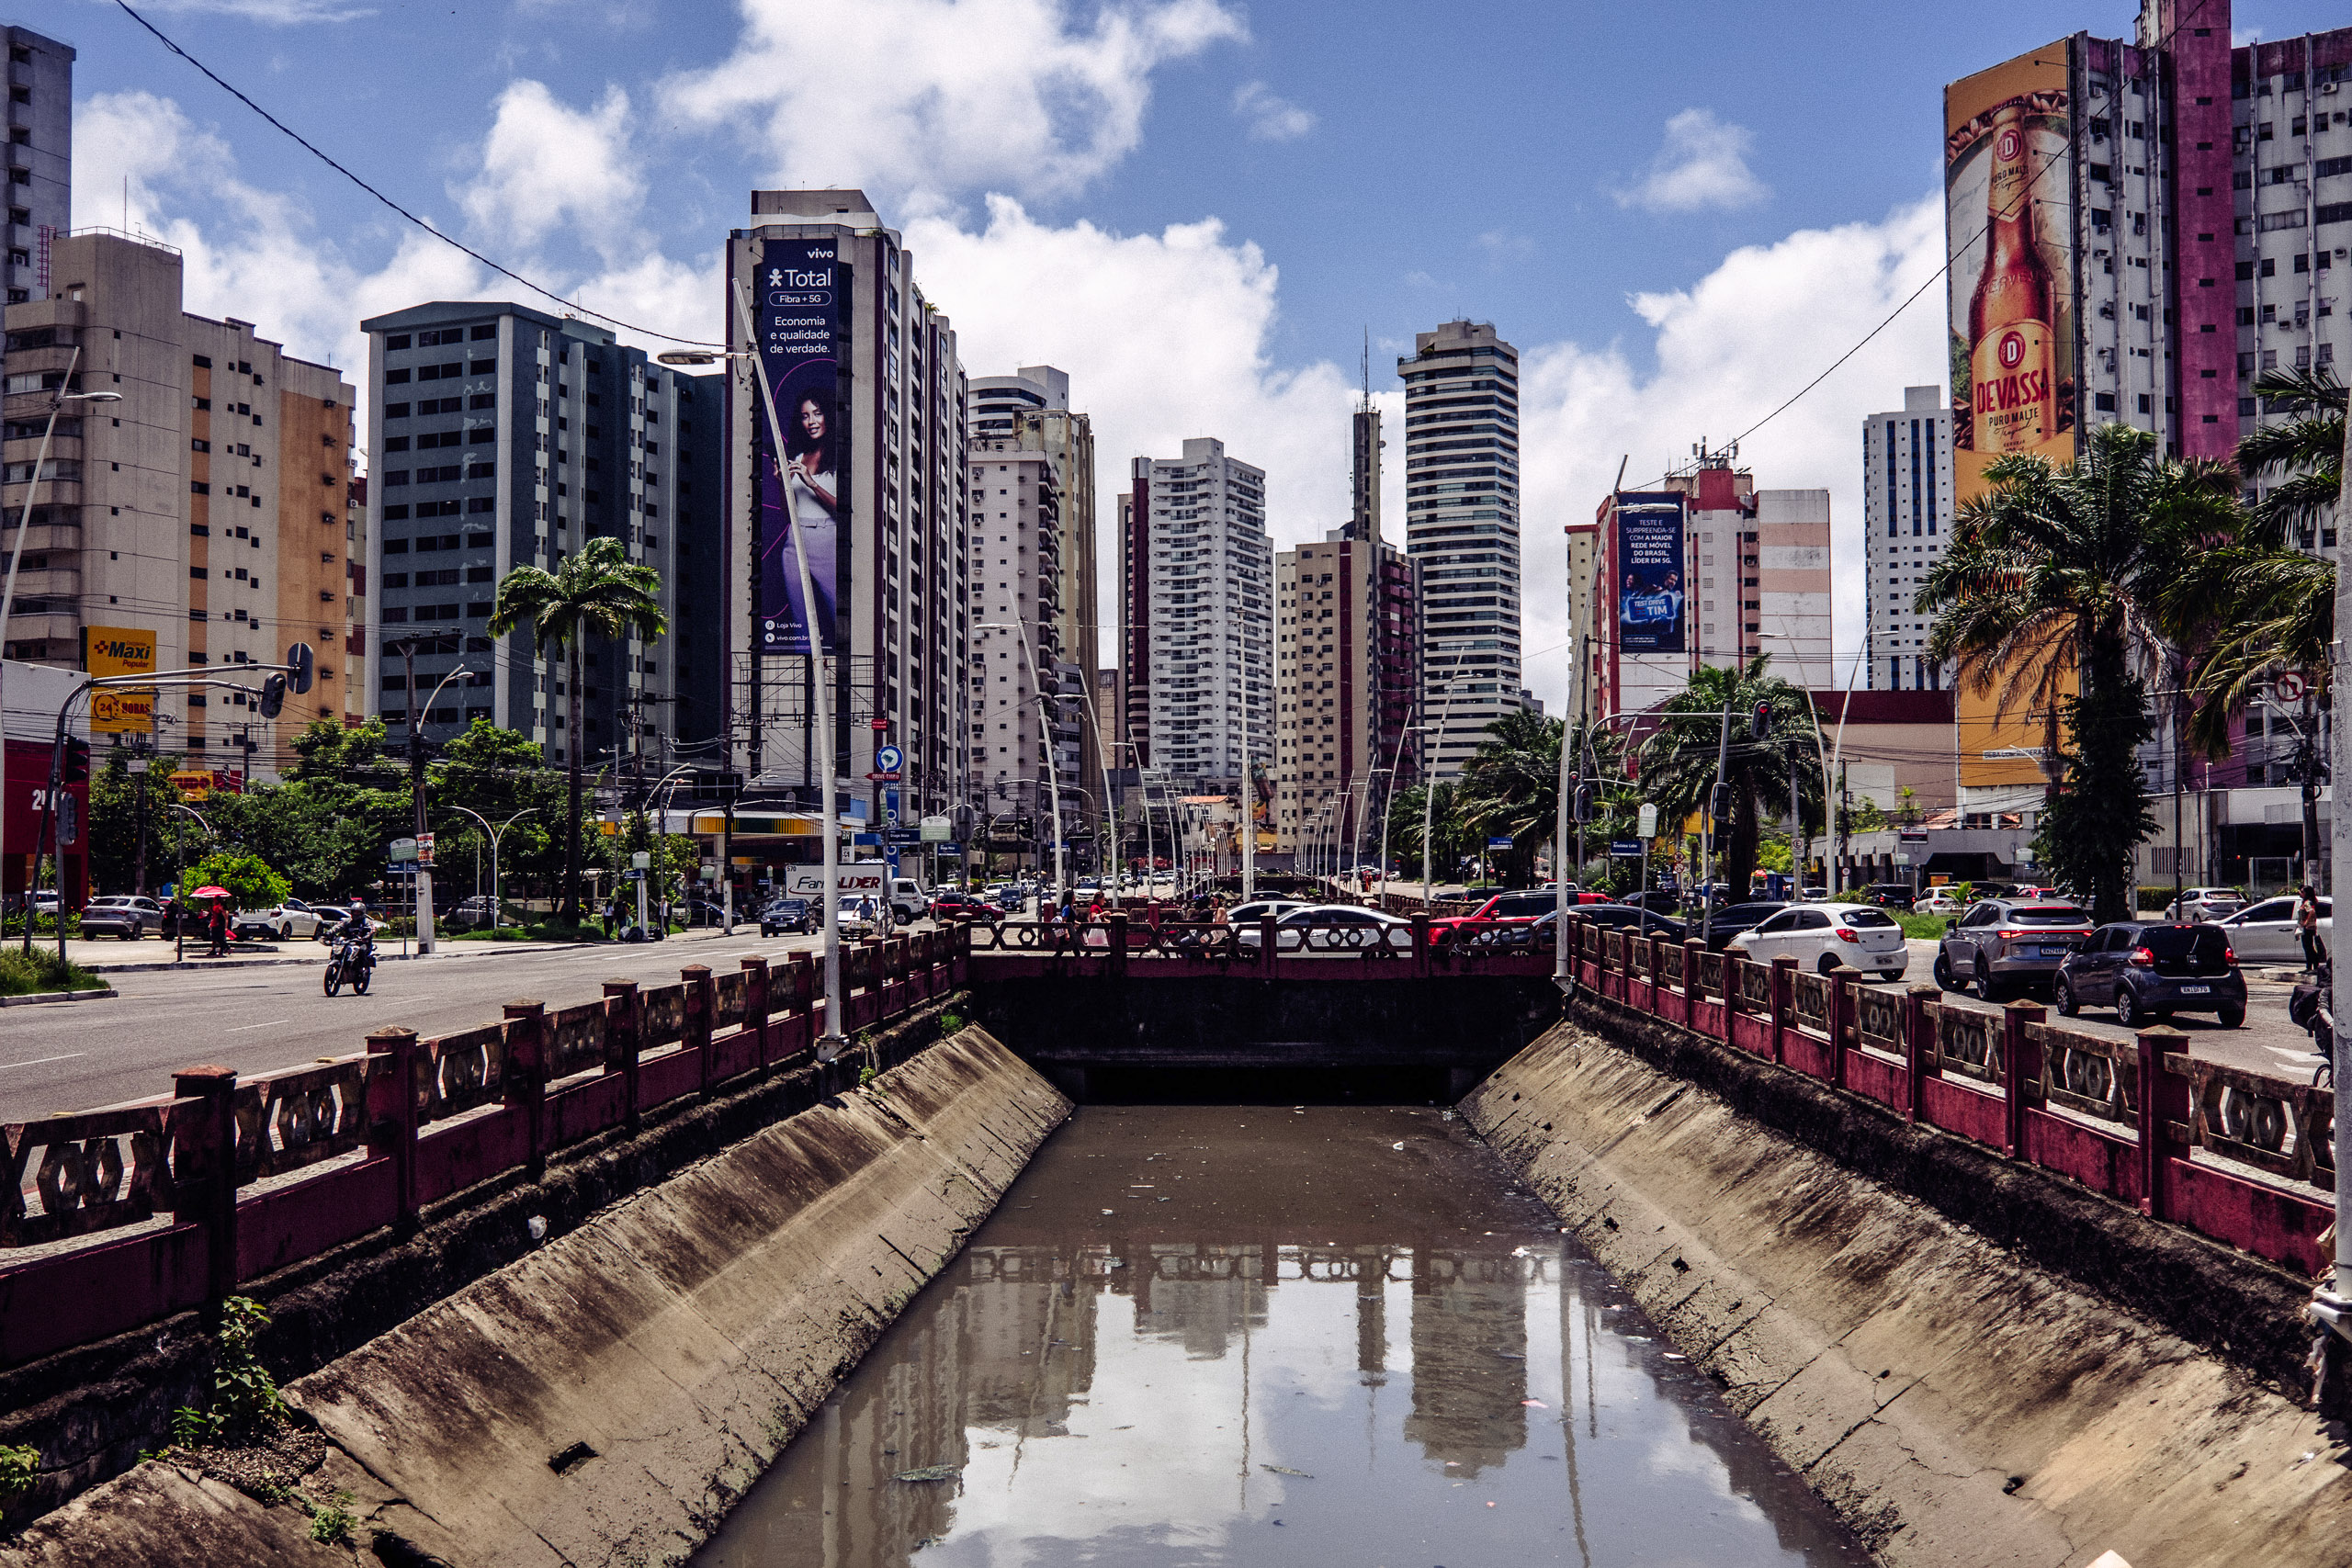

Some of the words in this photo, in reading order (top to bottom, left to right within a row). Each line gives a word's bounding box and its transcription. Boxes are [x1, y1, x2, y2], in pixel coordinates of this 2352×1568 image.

[808, 247, 834, 259] vivo
[784, 267, 831, 287] Total
[779, 294, 800, 303] Fibra
[808, 294, 821, 303] 5G
[775, 315, 826, 326] Economia
[770, 332, 777, 340] e
[779, 329, 831, 343] qualidade
[769, 344, 784, 354] de
[785, 343, 831, 354] verdade.
[2007, 340, 2018, 363] D
[1976, 367, 2051, 414] DEVASSA
[1988, 413, 2009, 427] PURO
[2011, 407, 2039, 423] MALTE
[1646, 604, 1668, 616] TIM
[107, 640, 151, 660] Maxi
[121, 659, 150, 669] Popular
[99, 703, 112, 712] 24
[121, 702, 151, 715] HORAS
